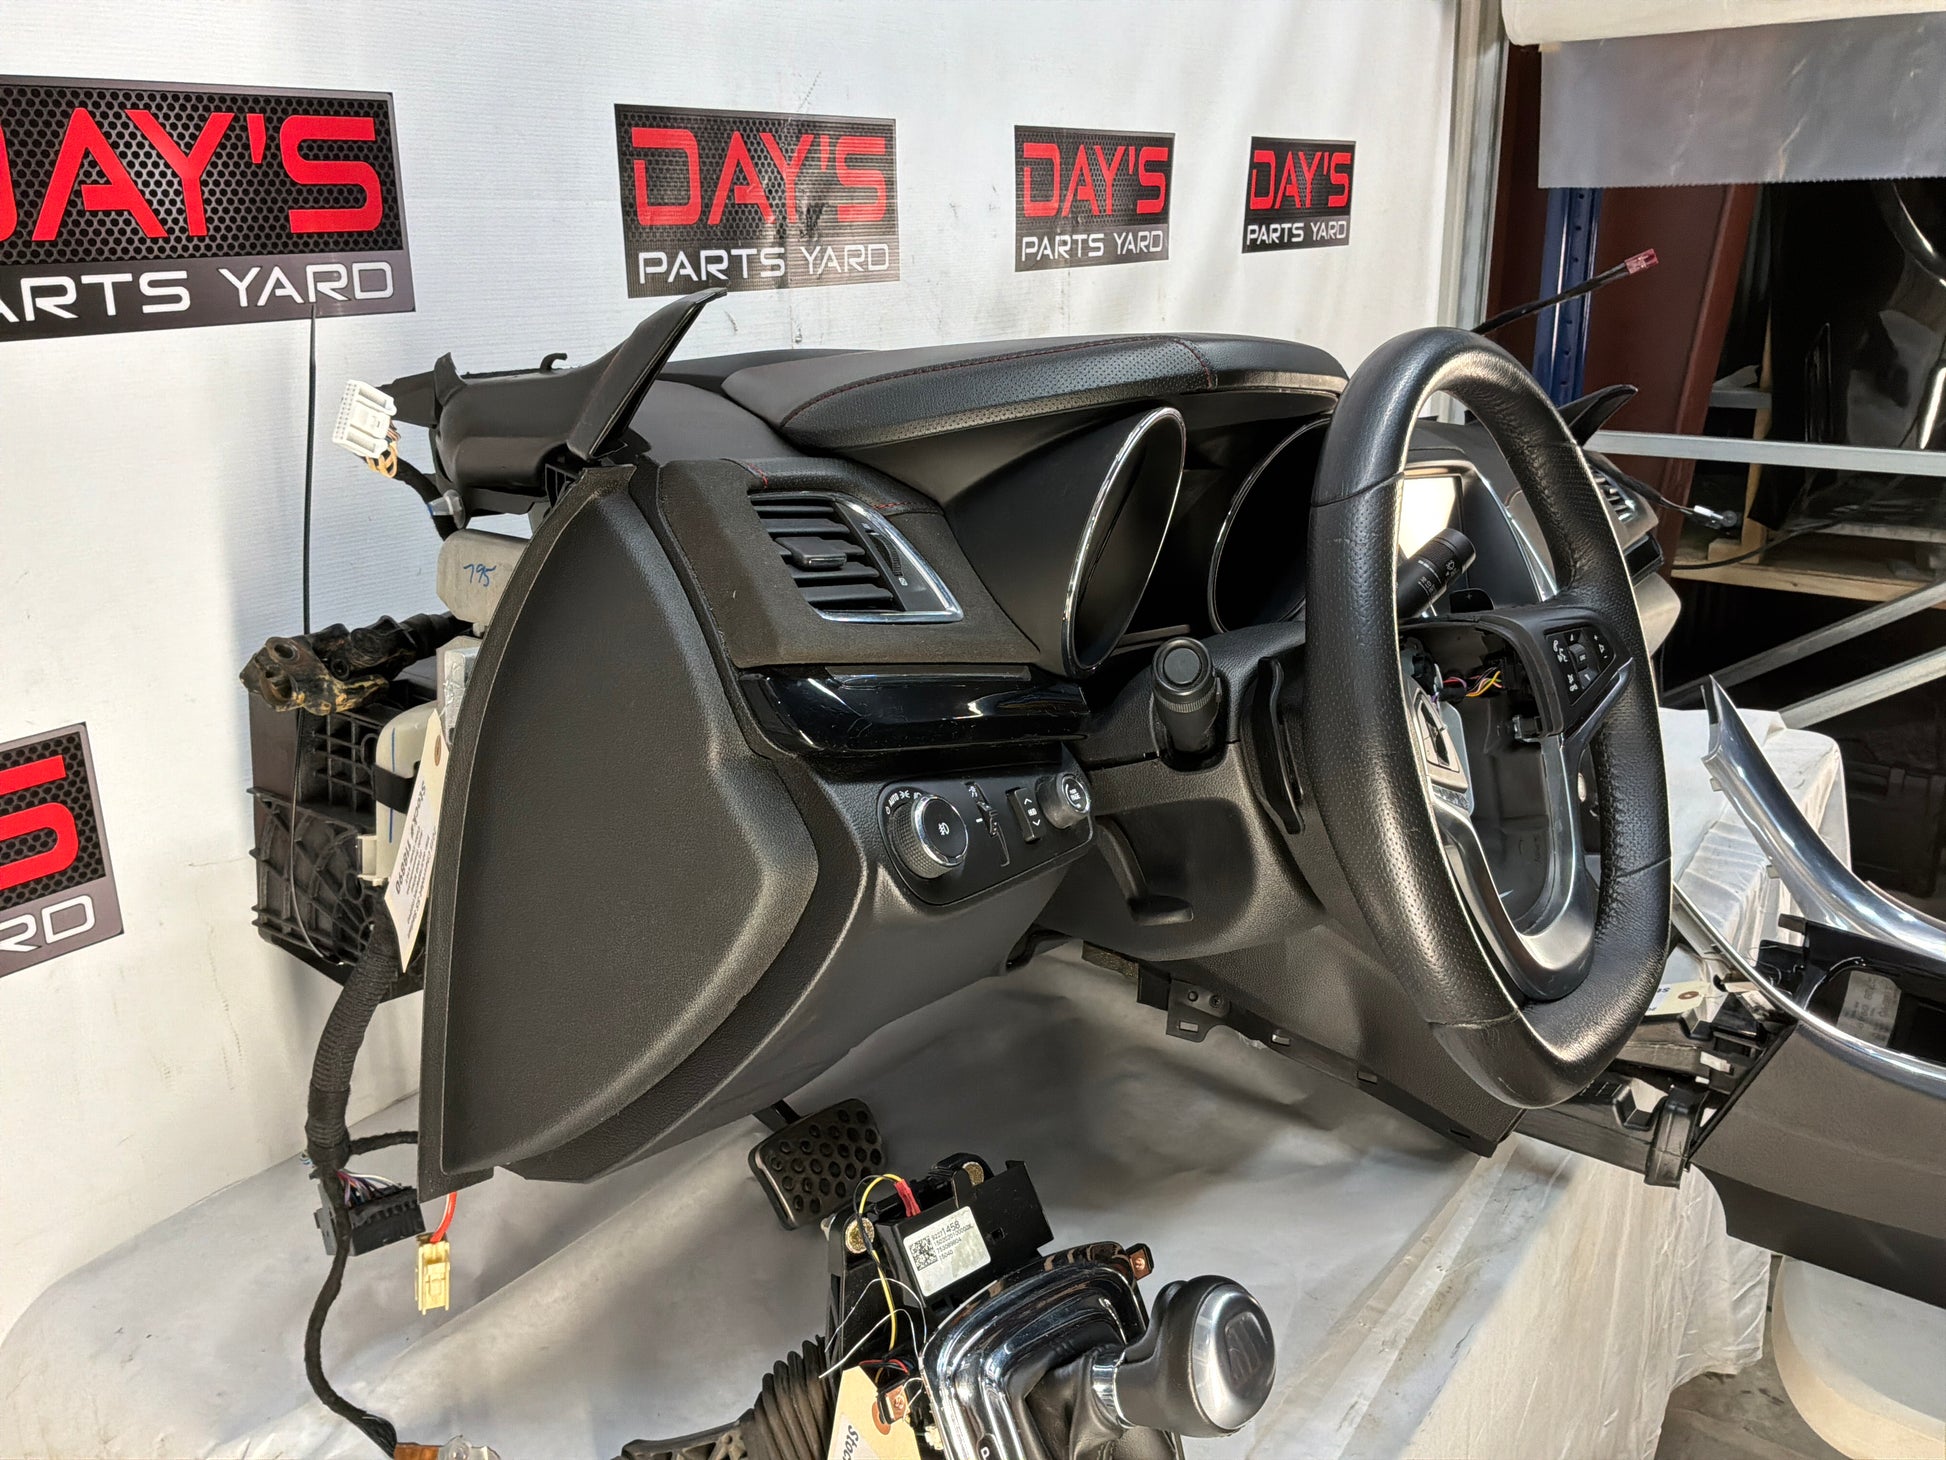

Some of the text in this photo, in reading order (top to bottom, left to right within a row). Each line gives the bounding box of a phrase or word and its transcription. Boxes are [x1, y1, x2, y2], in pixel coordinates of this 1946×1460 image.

[0, 107, 384, 242] AY'S
[631, 127, 887, 226] DAY'S
[1022, 143, 1169, 217] DAY'S
[1250, 150, 1352, 210] DAY'S
[1021, 230, 1164, 262] PARTS YARD
[1246, 220, 1348, 246] PARTS YARD
[217, 261, 395, 307] YARD
[637, 243, 890, 285] PARTS YARD
[463, 563, 497, 587] 795
[842, 1425, 860, 1460] Stoc
